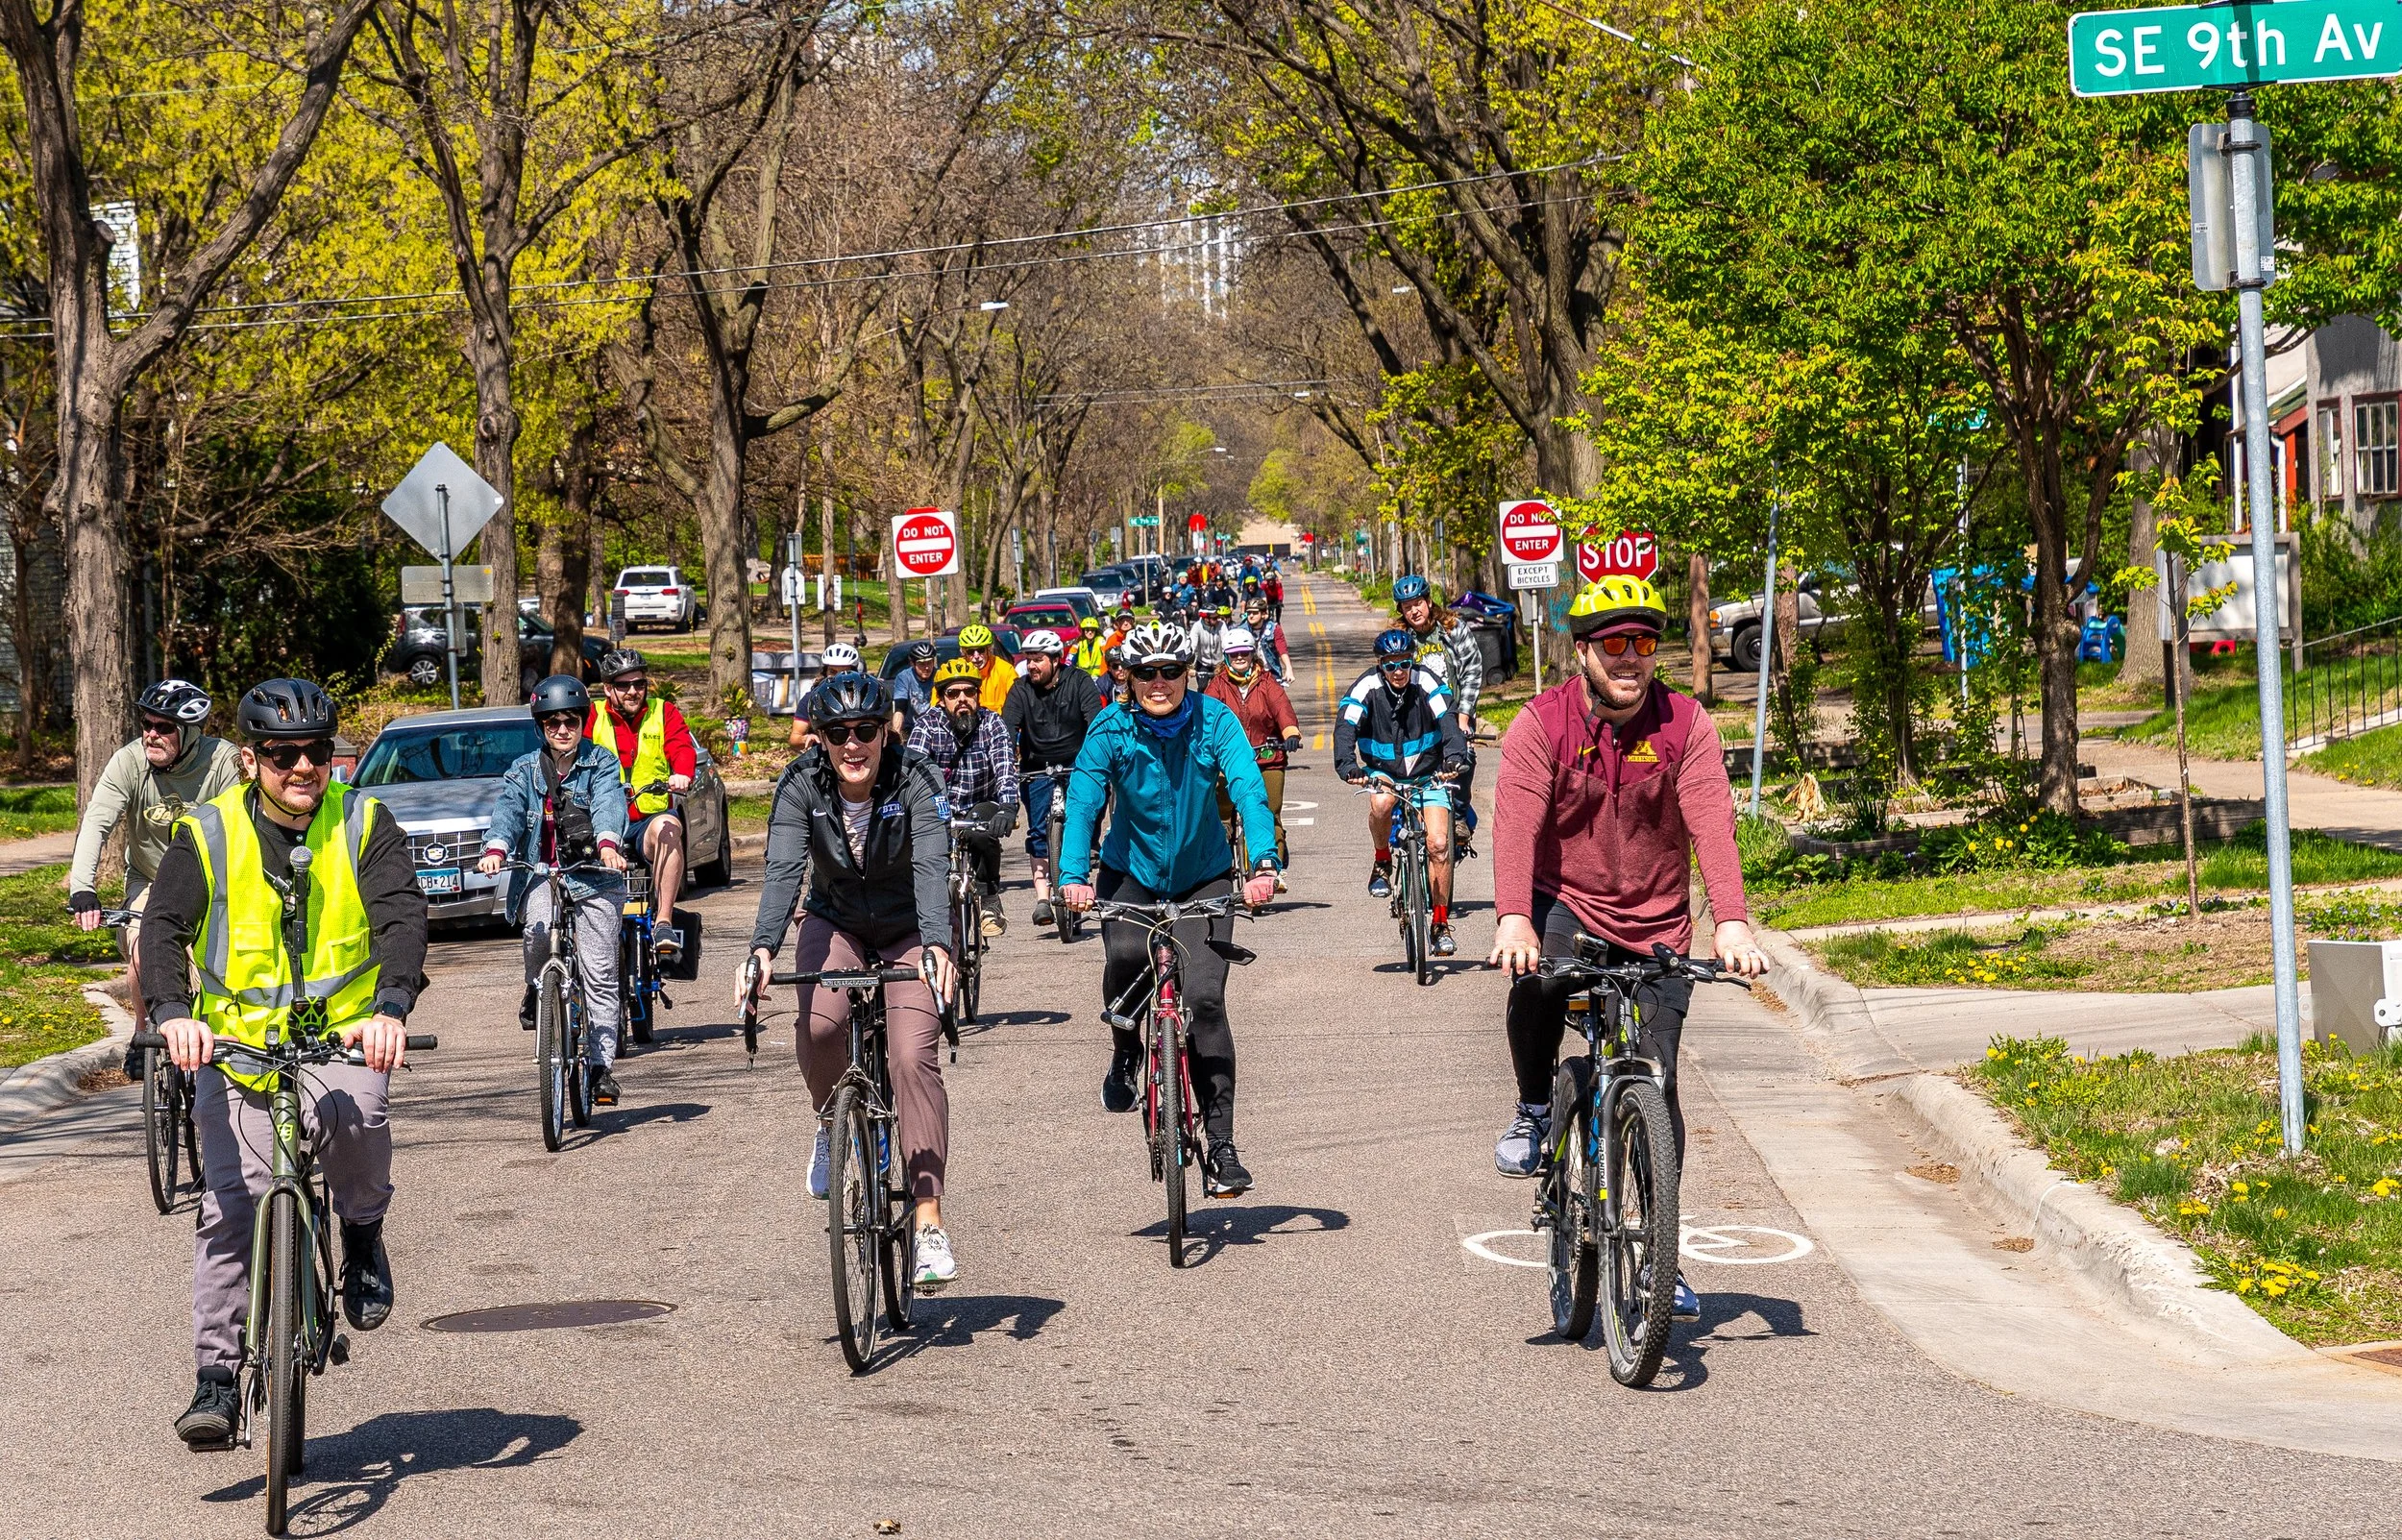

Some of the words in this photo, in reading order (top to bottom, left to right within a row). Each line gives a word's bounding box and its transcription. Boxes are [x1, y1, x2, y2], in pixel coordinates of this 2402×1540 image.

[2095, 25, 2165, 77] SE
[2187, 18, 2286, 70] 9th
[2313, 12, 2383, 63] Av
[1509, 514, 1525, 525] DO
[903, 527, 919, 538] DO
[924, 525, 944, 536] NOT
[1515, 539, 1550, 551] ENTER
[909, 552, 943, 565] ENTER
[1582, 537, 1653, 570] STOP
[1517, 566, 1548, 575] EXCEPT
[1517, 574, 1551, 585] BICYCLES
[440, 875, 457, 888] 214
